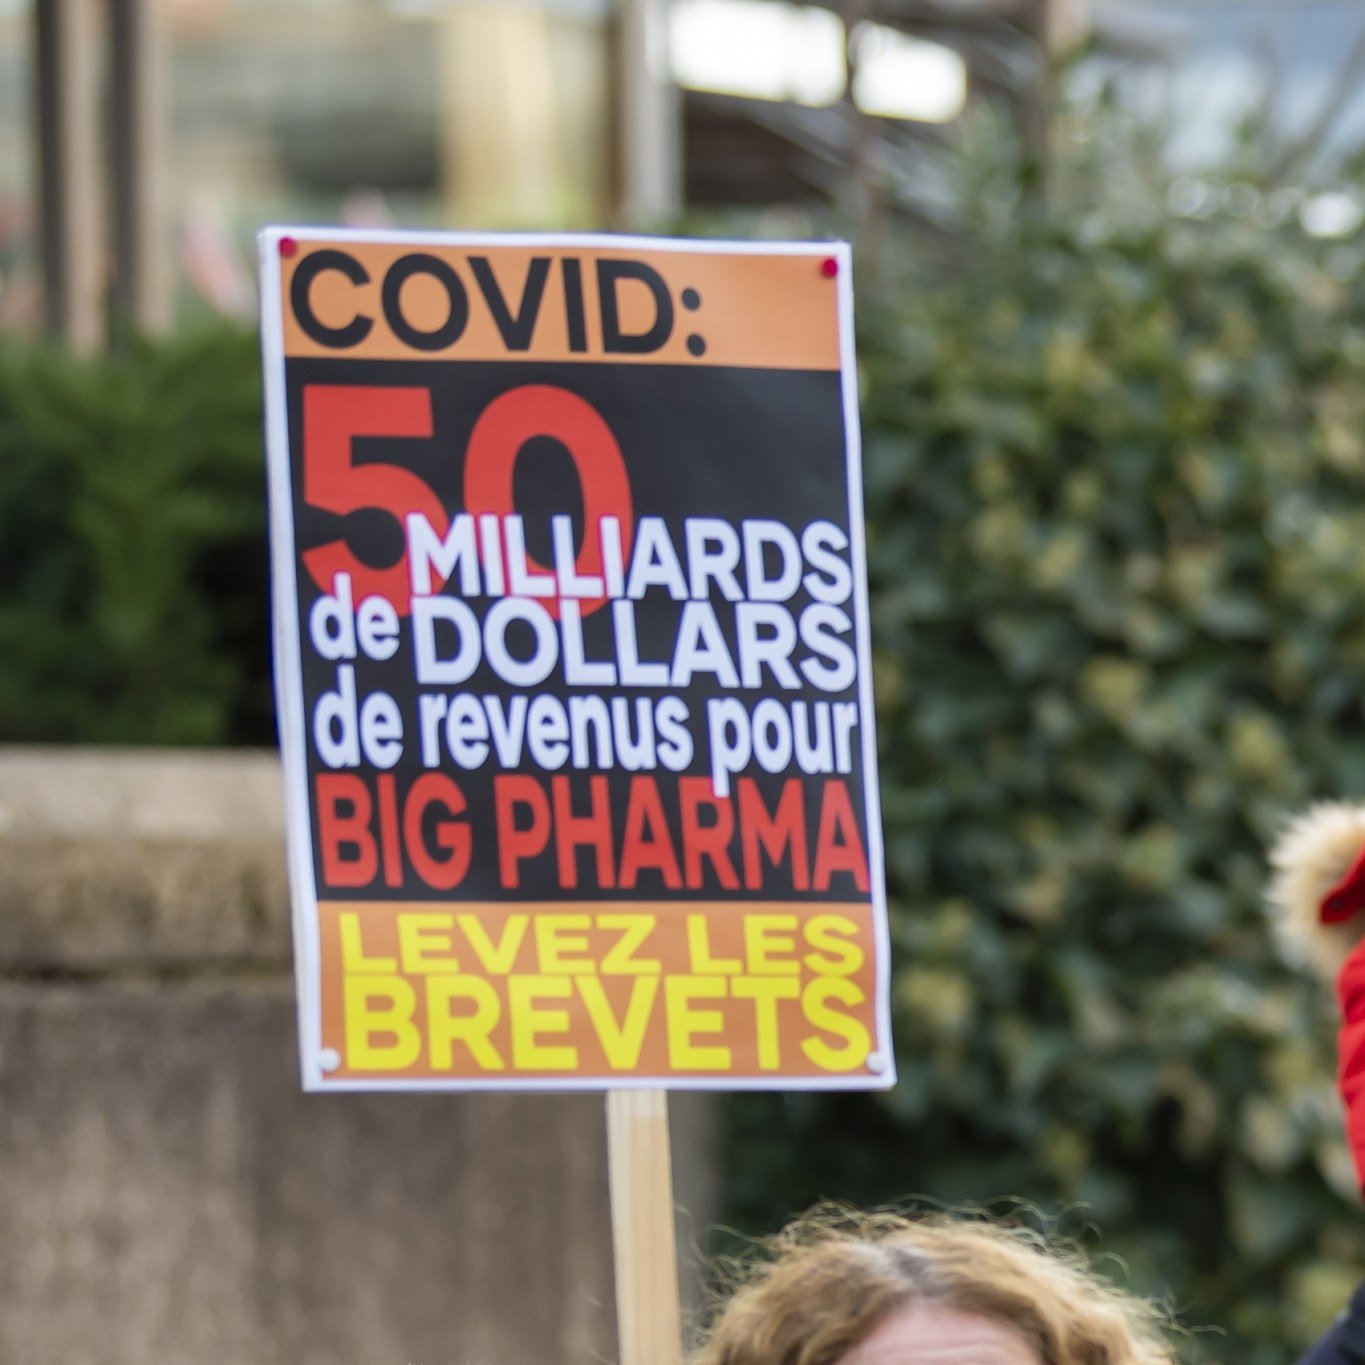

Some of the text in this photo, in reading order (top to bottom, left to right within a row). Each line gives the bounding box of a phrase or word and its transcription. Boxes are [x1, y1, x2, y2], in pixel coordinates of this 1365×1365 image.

[290, 249, 707, 356] COVID:
[302, 384, 633, 623] 50
[406, 513, 854, 605] MILLIARDS
[310, 572, 858, 692] de DOLLARS
[313, 665, 857, 798] de revenus pour
[315, 773, 870, 892] BIG PHARMA
[339, 912, 866, 978] LEVEZ LES
[344, 973, 872, 1072] BREVETS
